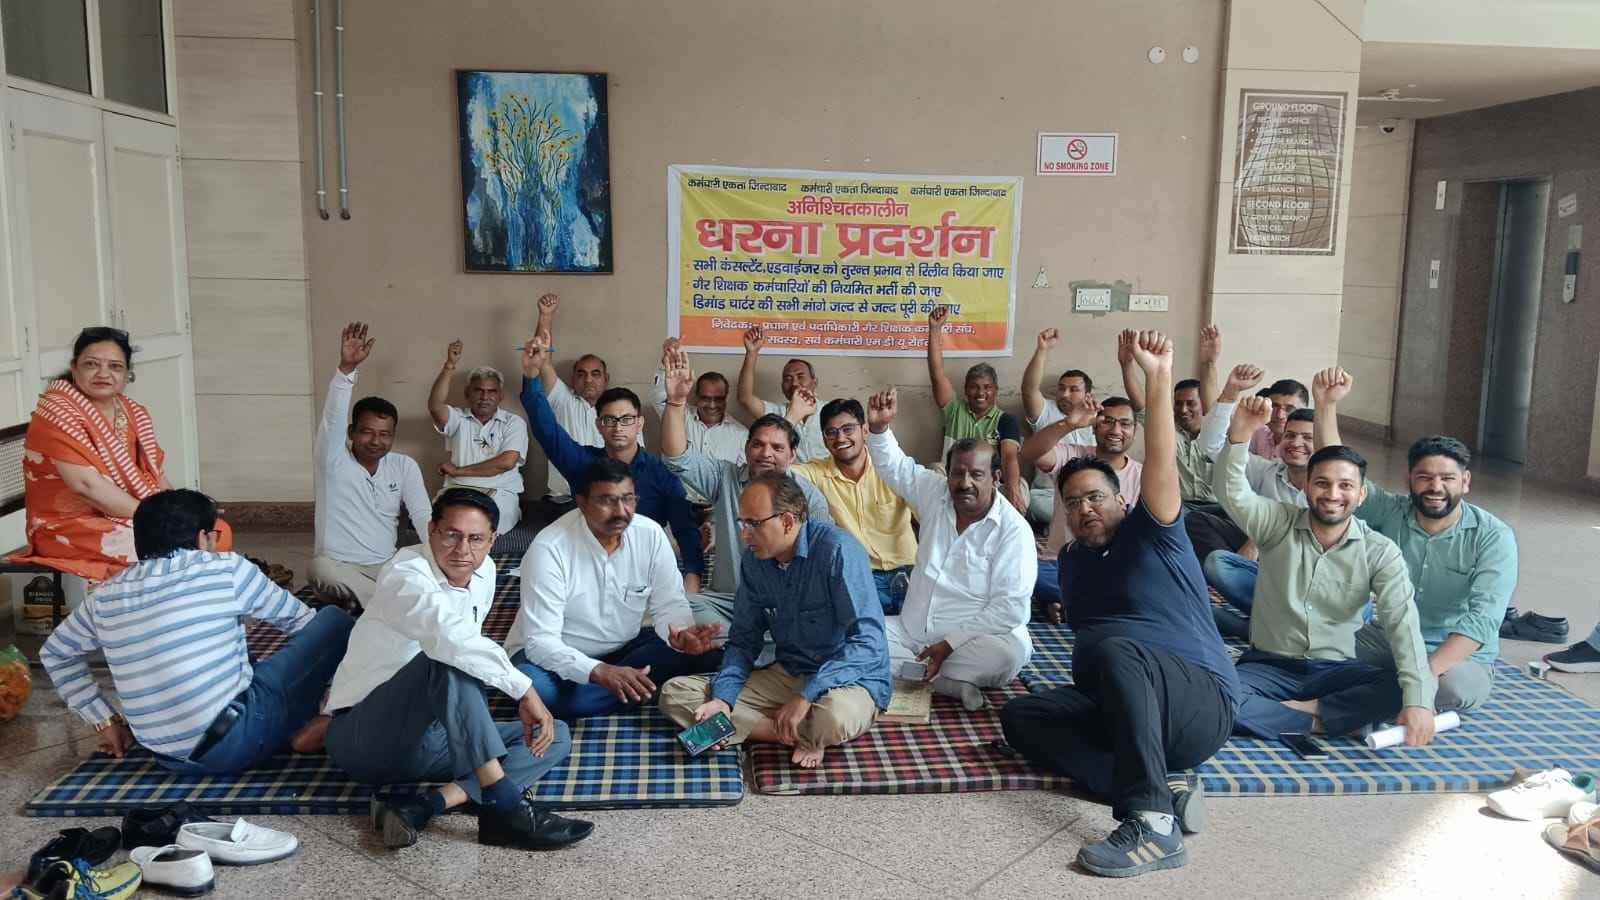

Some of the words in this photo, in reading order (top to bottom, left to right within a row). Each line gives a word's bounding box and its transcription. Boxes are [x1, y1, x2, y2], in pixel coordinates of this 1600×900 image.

[1044, 162, 1055, 170] NO
[1056, 162, 1089, 170] SMOKING
[1090, 162, 1110, 170] ZONE
[688, 176, 720, 189] कर्मचारी
[723, 180, 746, 190] एकता
[800, 182, 833, 194] कर्मचारी
[835, 184, 858, 194] एकता
[910, 184, 942, 196] कर्मचारी
[944, 187, 967, 197] एकता
[786, 196, 909, 217] अनिश्चितकालीन
[696, 218, 823, 255] धरना
[836, 211, 996, 258] प्रदर्शन
[693, 257, 717, 271] सभी
[823, 261, 838, 275] को
[842, 264, 869, 280] तुरन्त
[873, 264, 902, 277] प्रभाव
[905, 262, 915, 277] से
[918, 262, 948, 277] रिलीव
[952, 263, 979, 278] किया
[982, 267, 1004, 279] जाए
[713, 276, 749, 291] शिक्षक
[753, 277, 811, 293] कर्मचारियों
[812, 279, 827, 294] की
[831, 279, 872, 295] नियमित
[876, 281, 897, 296] भर्ती
[901, 282, 917, 296] की
[920, 286, 942, 297] जाए
[693, 294, 726, 310] डिमांड
[729, 296, 755, 310] चार्टर
[758, 296, 772, 311] की
[776, 297, 800, 311] सभी
[830, 302, 854, 313] जल्द
[858, 299, 868, 313] से
[871, 302, 896, 314] जल्द
[900, 299, 917, 318] पूरी
[921, 299, 936, 313] की
[824, 335, 863, 346] कर्मचारी
